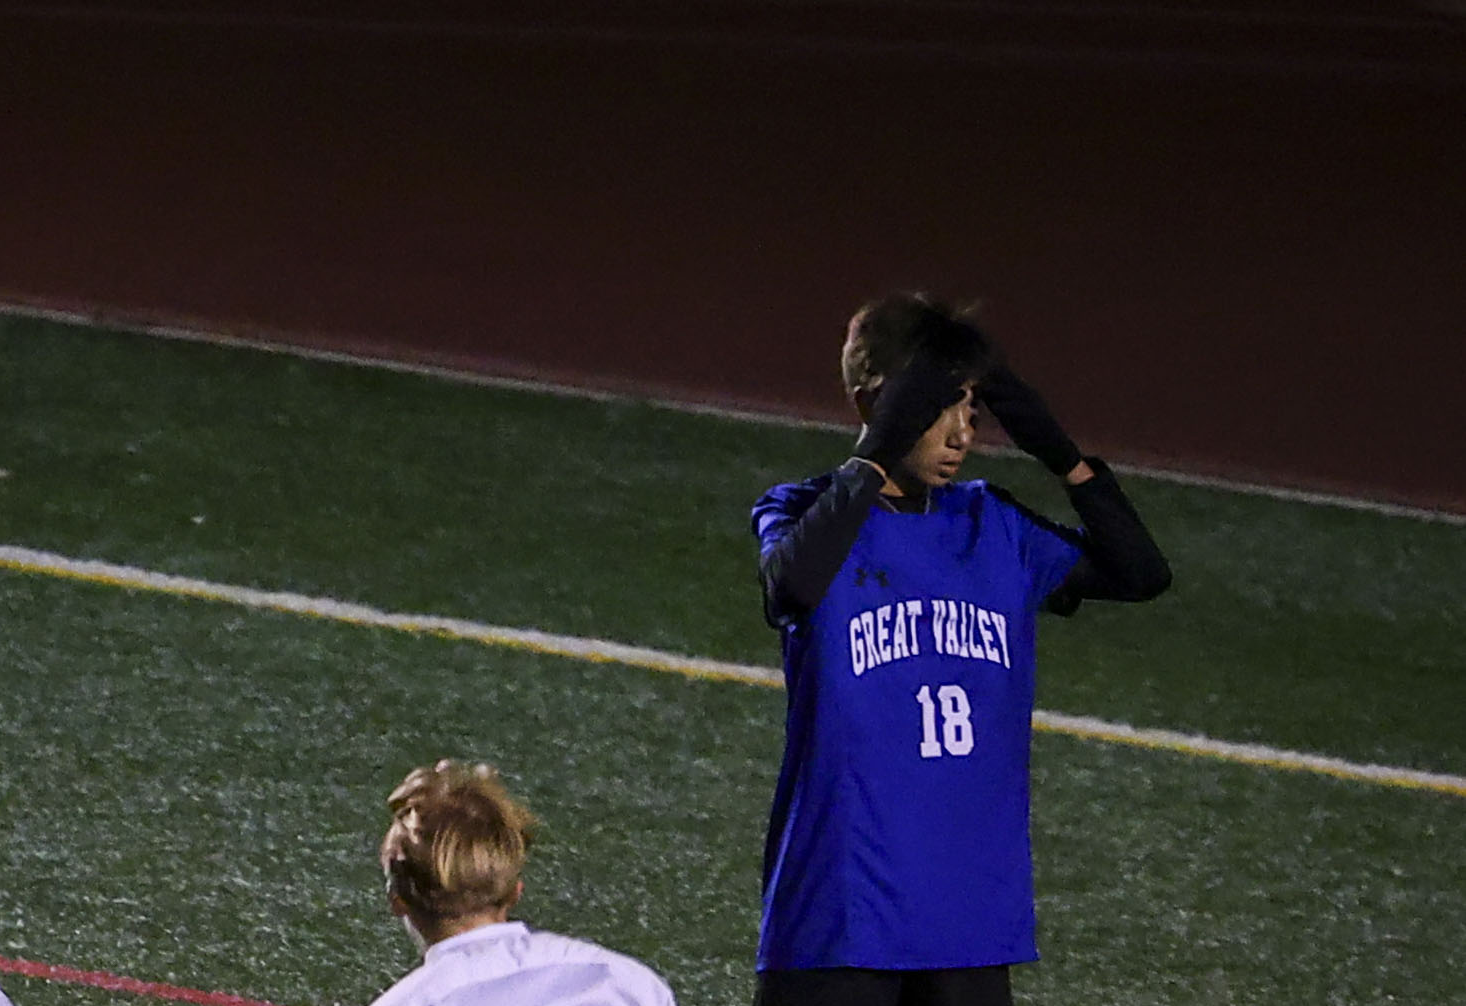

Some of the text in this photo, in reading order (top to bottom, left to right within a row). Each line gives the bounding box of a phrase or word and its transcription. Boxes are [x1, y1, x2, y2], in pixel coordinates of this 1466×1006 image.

[848, 599, 1011, 677] GREAT VALLEY
[916, 684, 974, 758] 18
